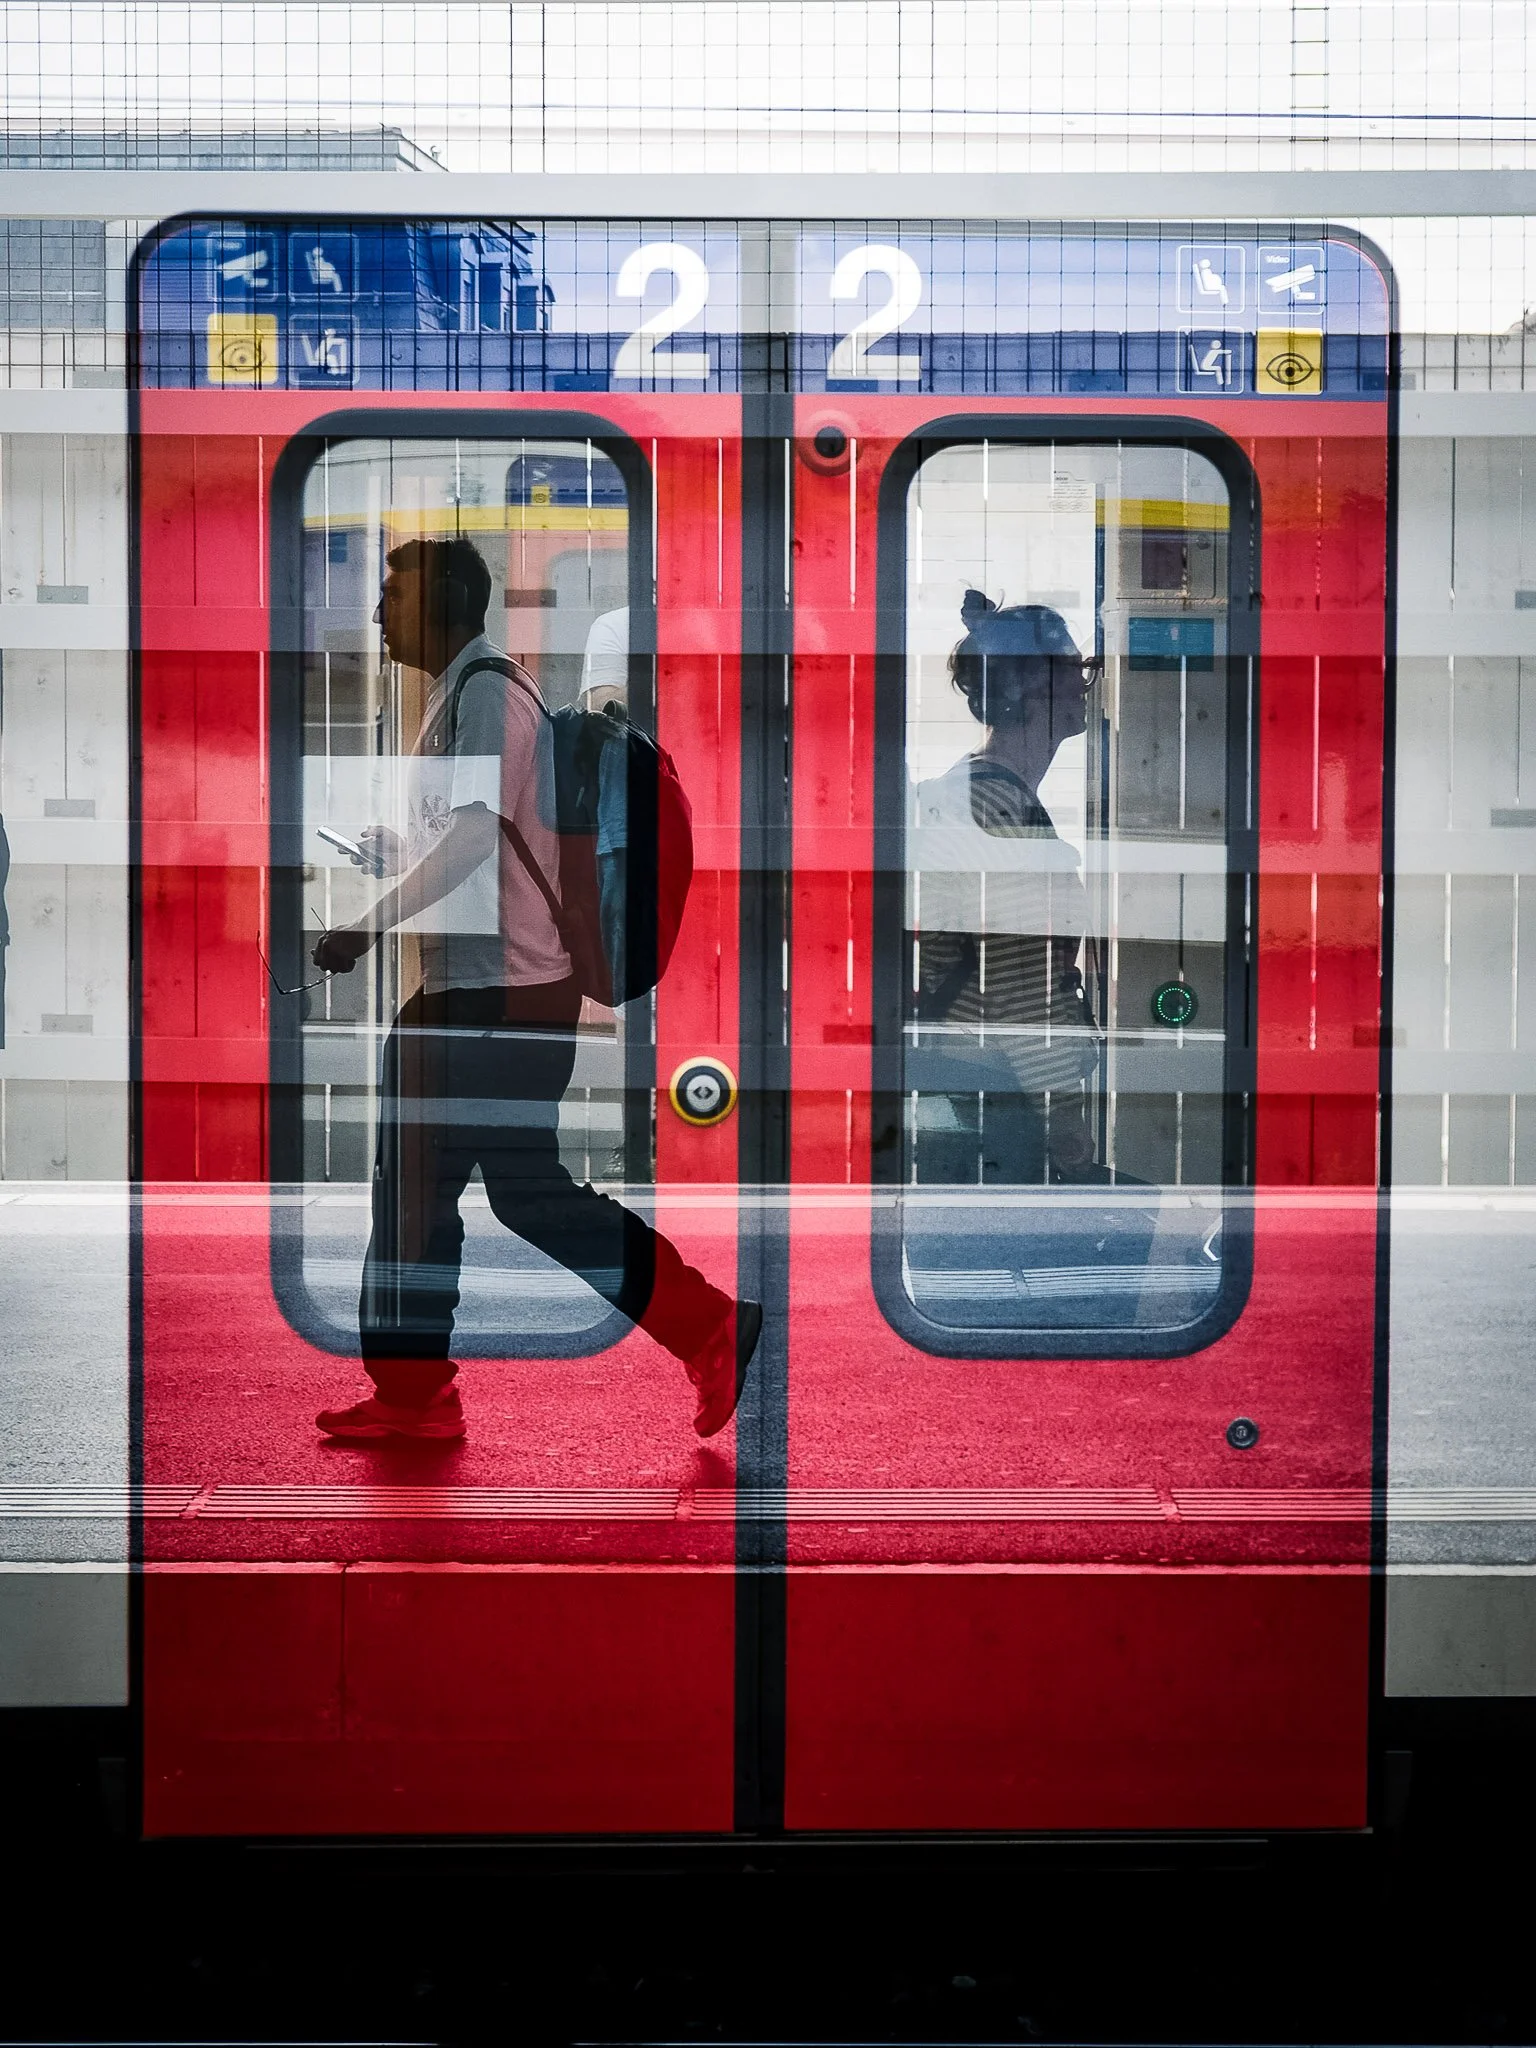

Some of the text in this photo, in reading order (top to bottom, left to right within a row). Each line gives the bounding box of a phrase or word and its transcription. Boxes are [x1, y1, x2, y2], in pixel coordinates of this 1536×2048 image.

[613, 242, 711, 380] 2
[827, 243, 923, 381] 2
[1265, 255, 1290, 264] Video
